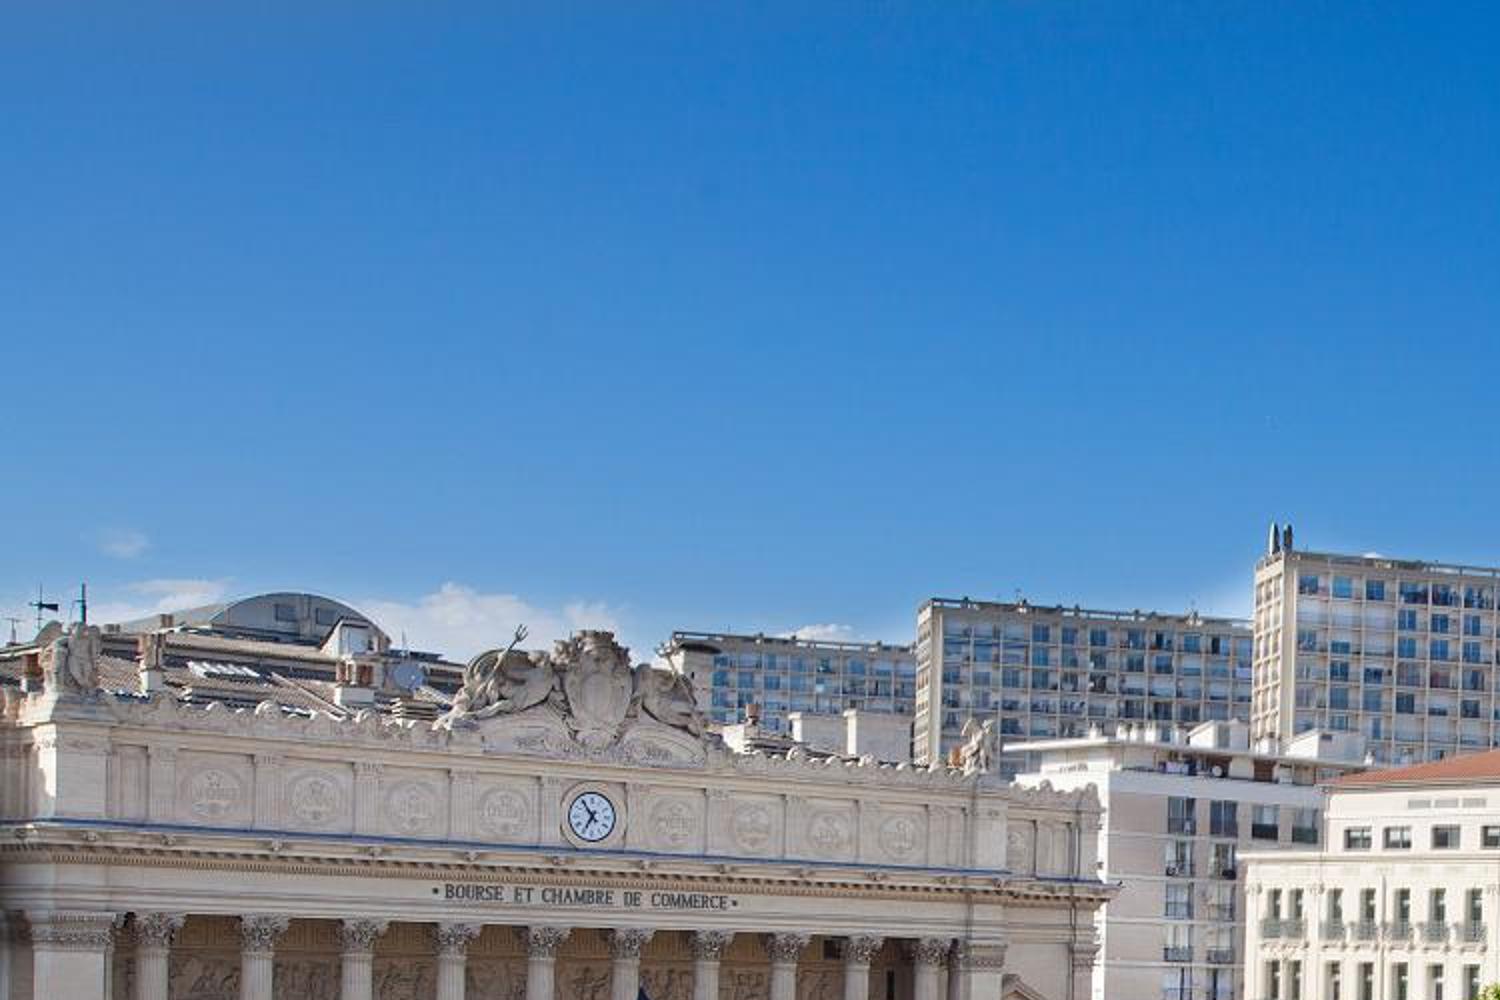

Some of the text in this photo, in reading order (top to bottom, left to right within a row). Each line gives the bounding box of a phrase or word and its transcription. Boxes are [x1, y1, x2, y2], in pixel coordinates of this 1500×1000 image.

[445, 884, 728, 909] BOURSE ET CHAMBRE DE COMMERCE
